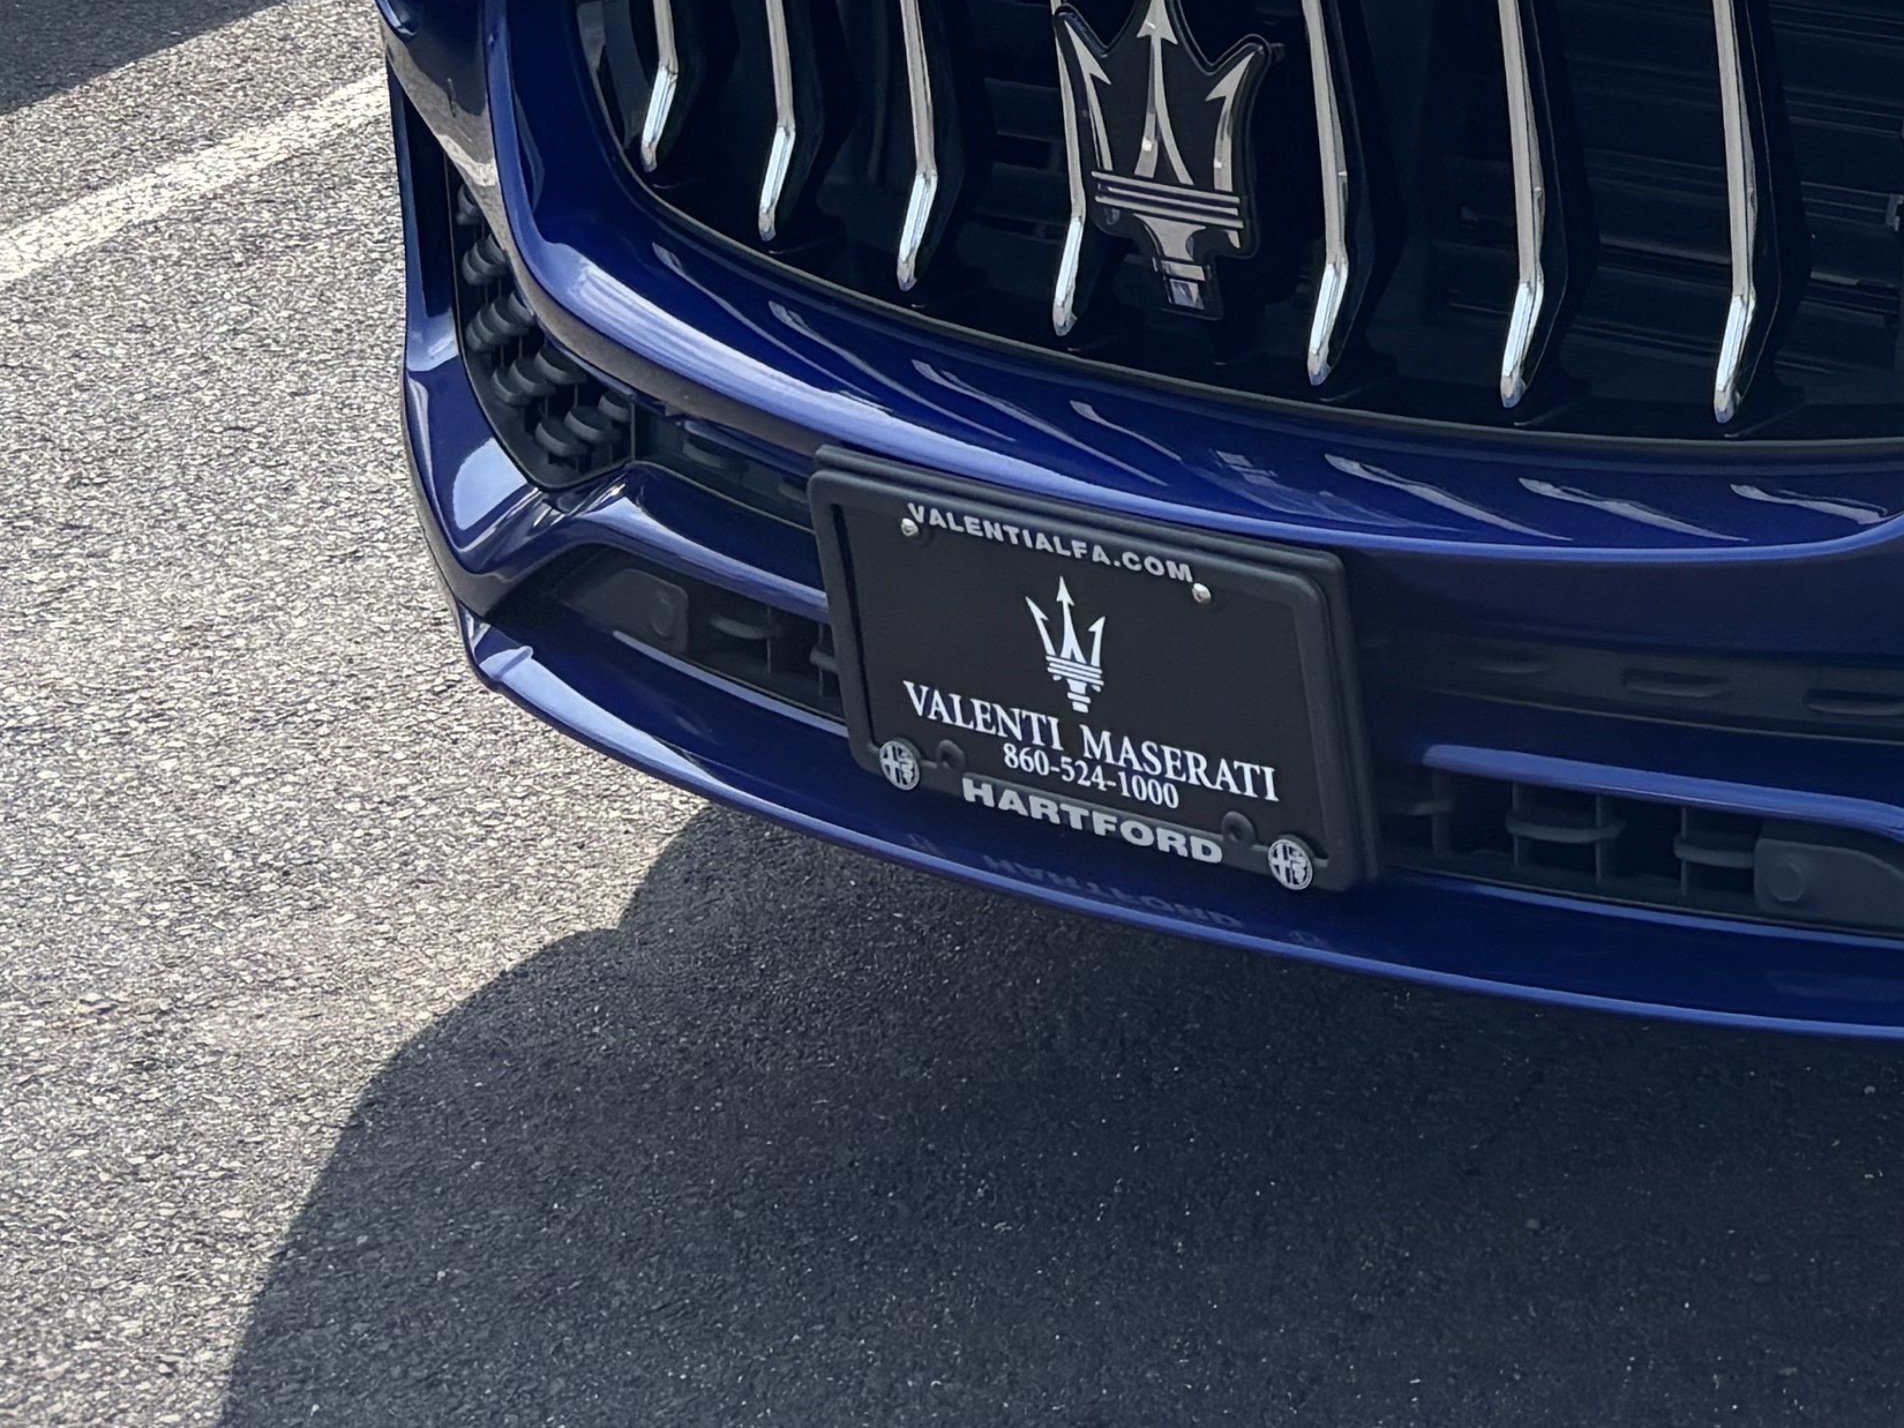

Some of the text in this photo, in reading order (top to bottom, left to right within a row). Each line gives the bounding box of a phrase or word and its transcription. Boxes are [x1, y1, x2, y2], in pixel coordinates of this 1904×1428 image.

[906, 502, 1194, 584] VALENTIALFA.COM
[902, 680, 1281, 802] VALENTI MASERATI
[1003, 742, 1181, 810] 860-524-1000
[961, 776, 1224, 865] HARTFORD
